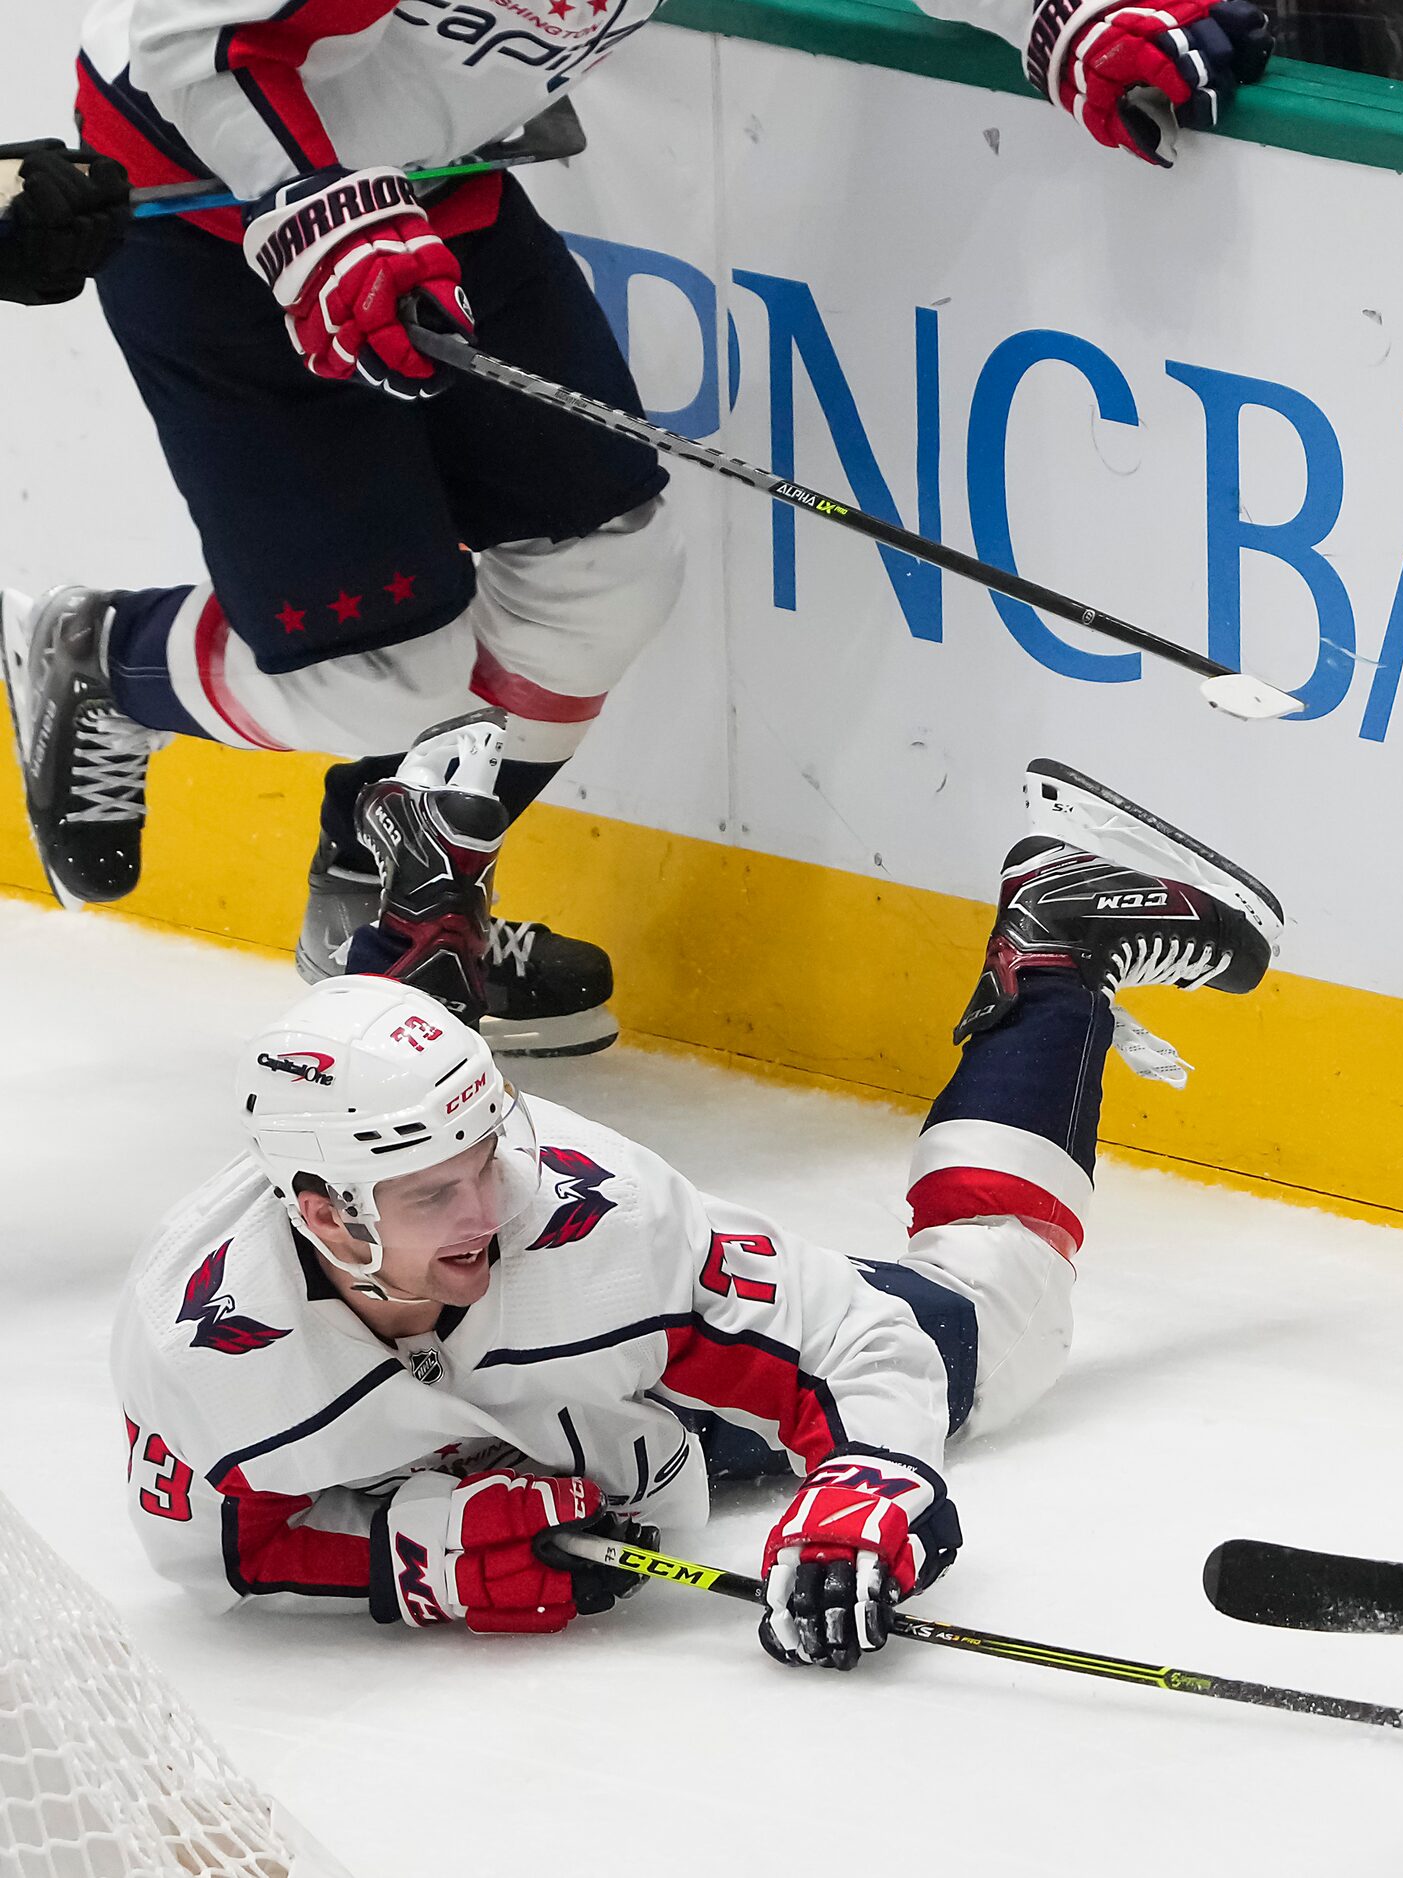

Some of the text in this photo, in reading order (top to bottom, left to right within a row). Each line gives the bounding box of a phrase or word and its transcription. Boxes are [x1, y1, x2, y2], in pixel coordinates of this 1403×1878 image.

[256, 175, 418, 288] WARRIOR
[776, 484, 816, 507] ALPHA
[816, 499, 836, 514] LX
[374, 806, 402, 847] CCM
[1097, 892, 1168, 910] CCM
[390, 1015, 444, 1052] 73
[446, 1072, 487, 1115] CCM
[417, 1357, 436, 1379] NHL
[604, 1546, 617, 1563] 73
[618, 1550, 705, 1585] CCM
